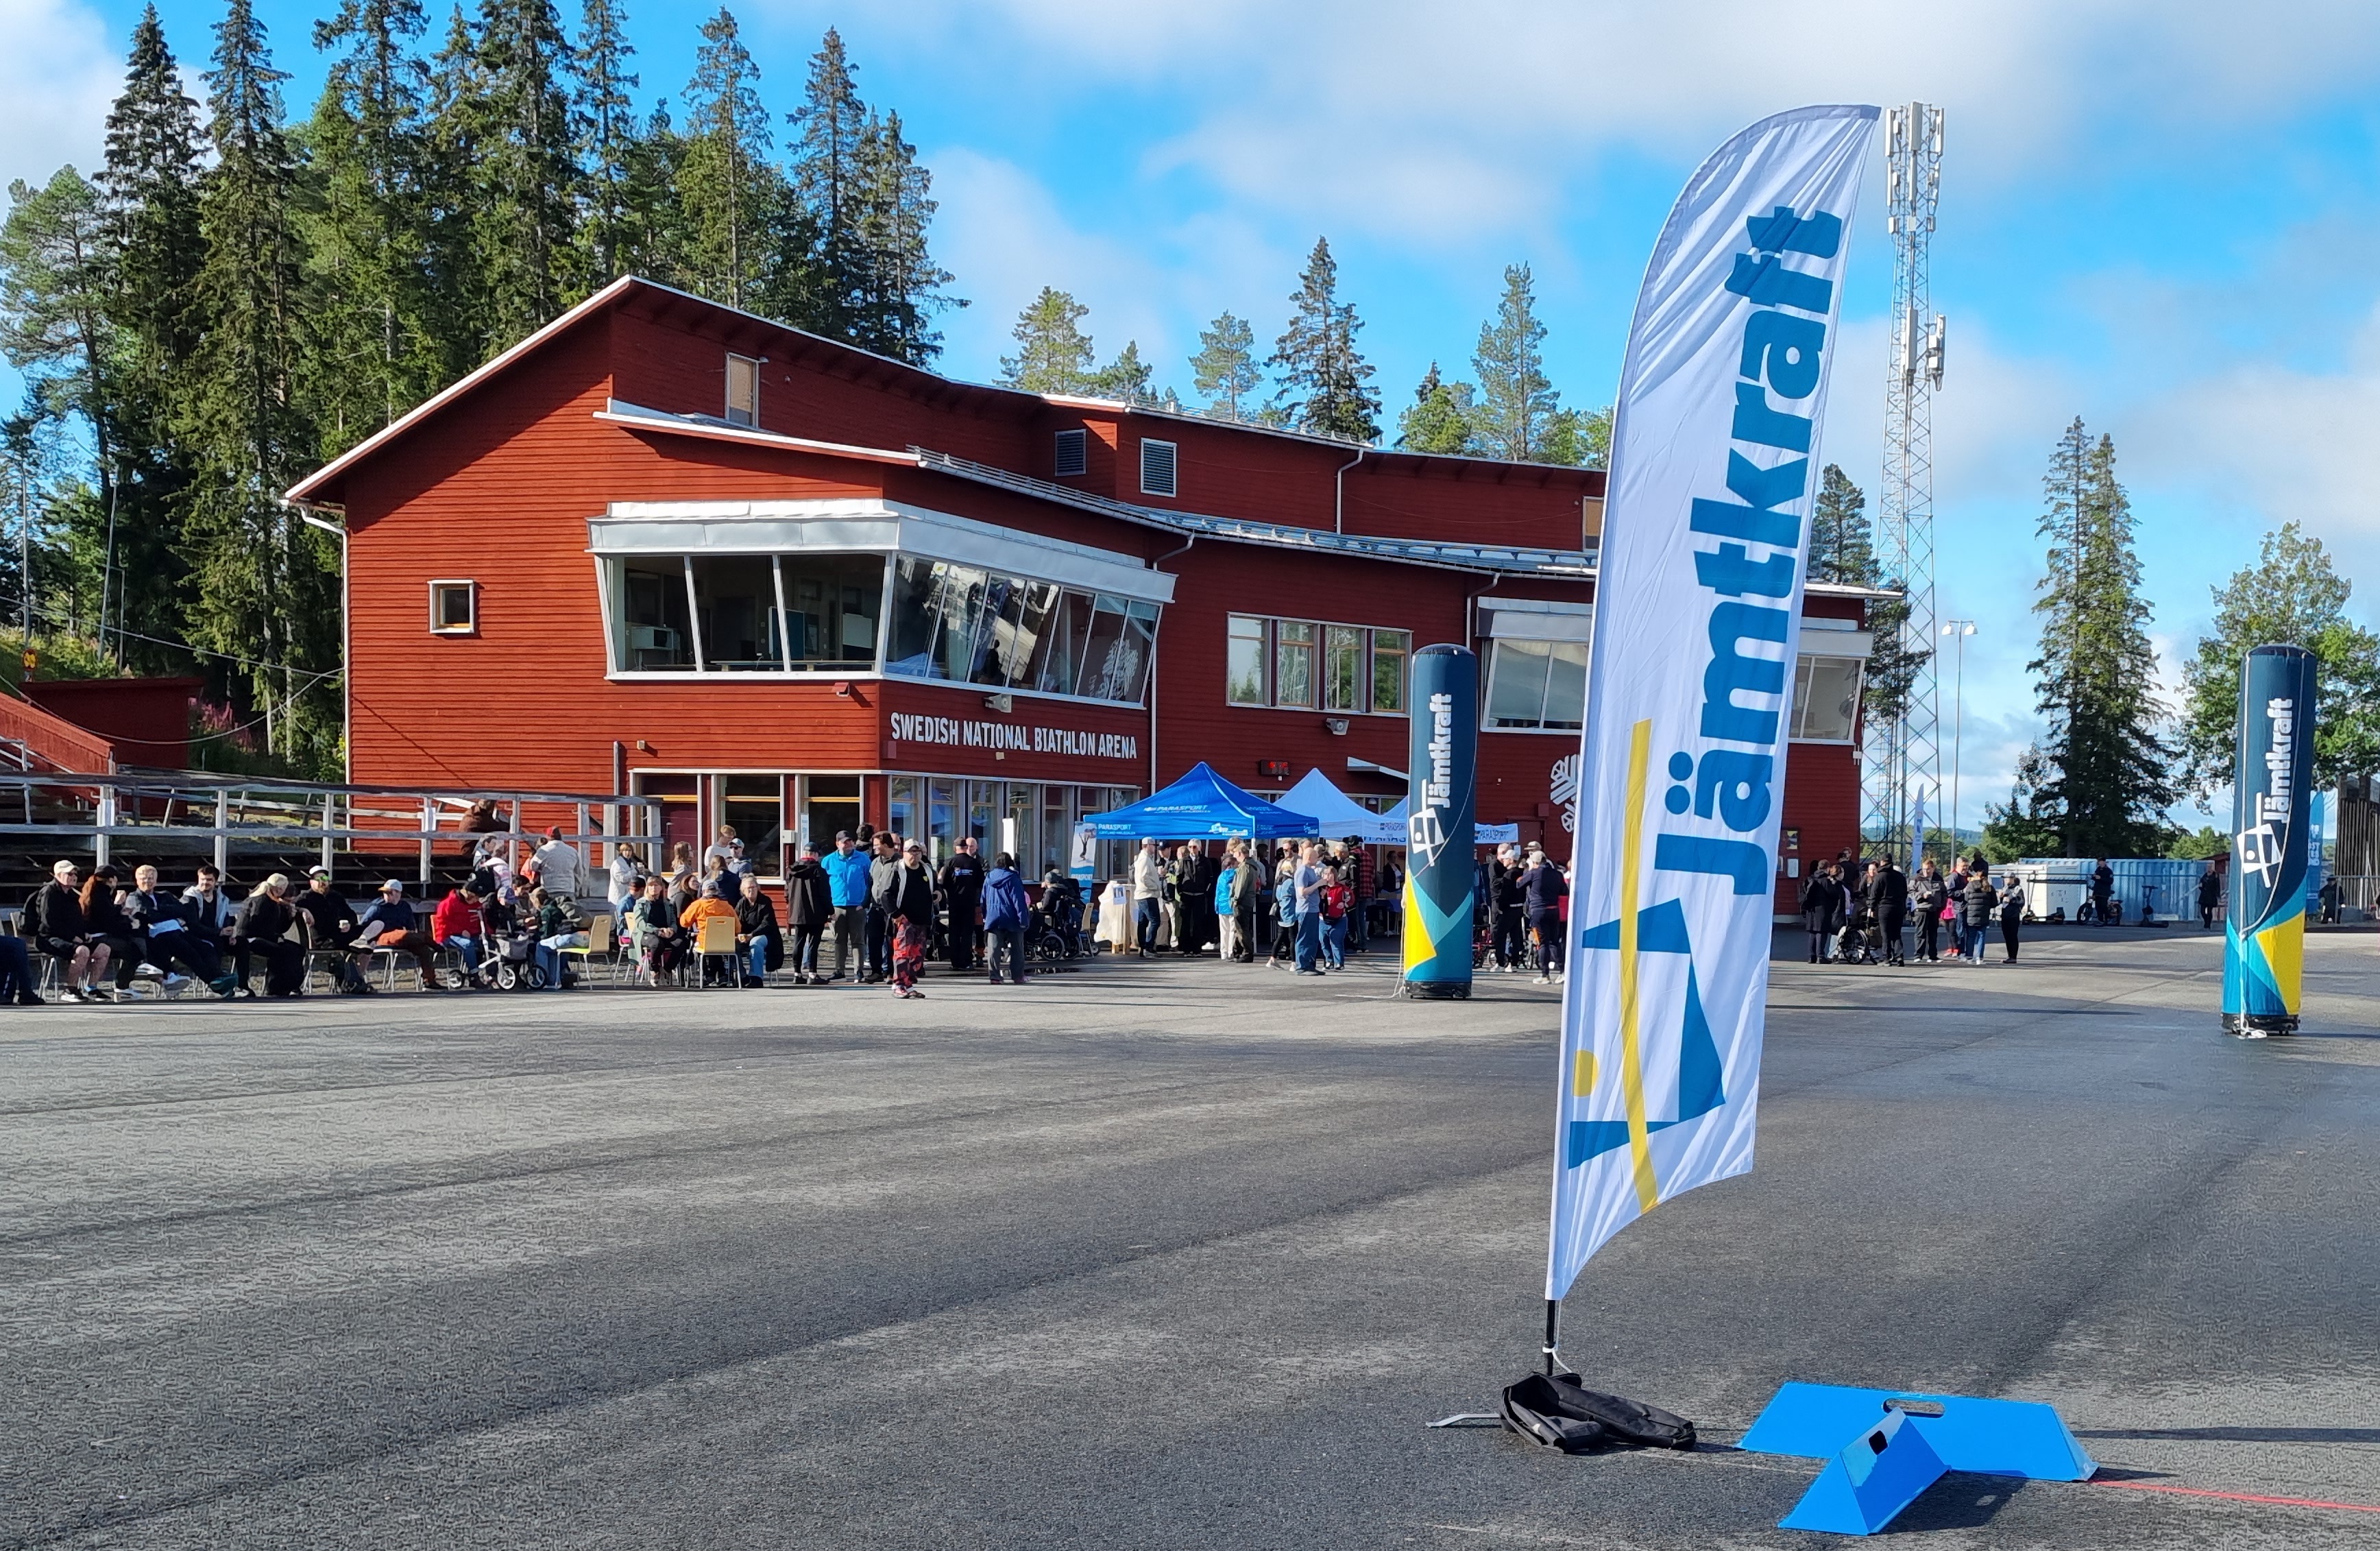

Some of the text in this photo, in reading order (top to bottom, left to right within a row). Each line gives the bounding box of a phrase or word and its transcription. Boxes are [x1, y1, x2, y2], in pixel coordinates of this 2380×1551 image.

[1654, 206, 1843, 896] Jämtkraft
[890, 712, 1138, 760] SWEDISH NATIONAL BIATHLON ARENA
[1427, 693, 1452, 808] Jämtkraft
[2263, 698, 2293, 823] Jämtkraft
[1097, 823, 1132, 831] PARASPORT
